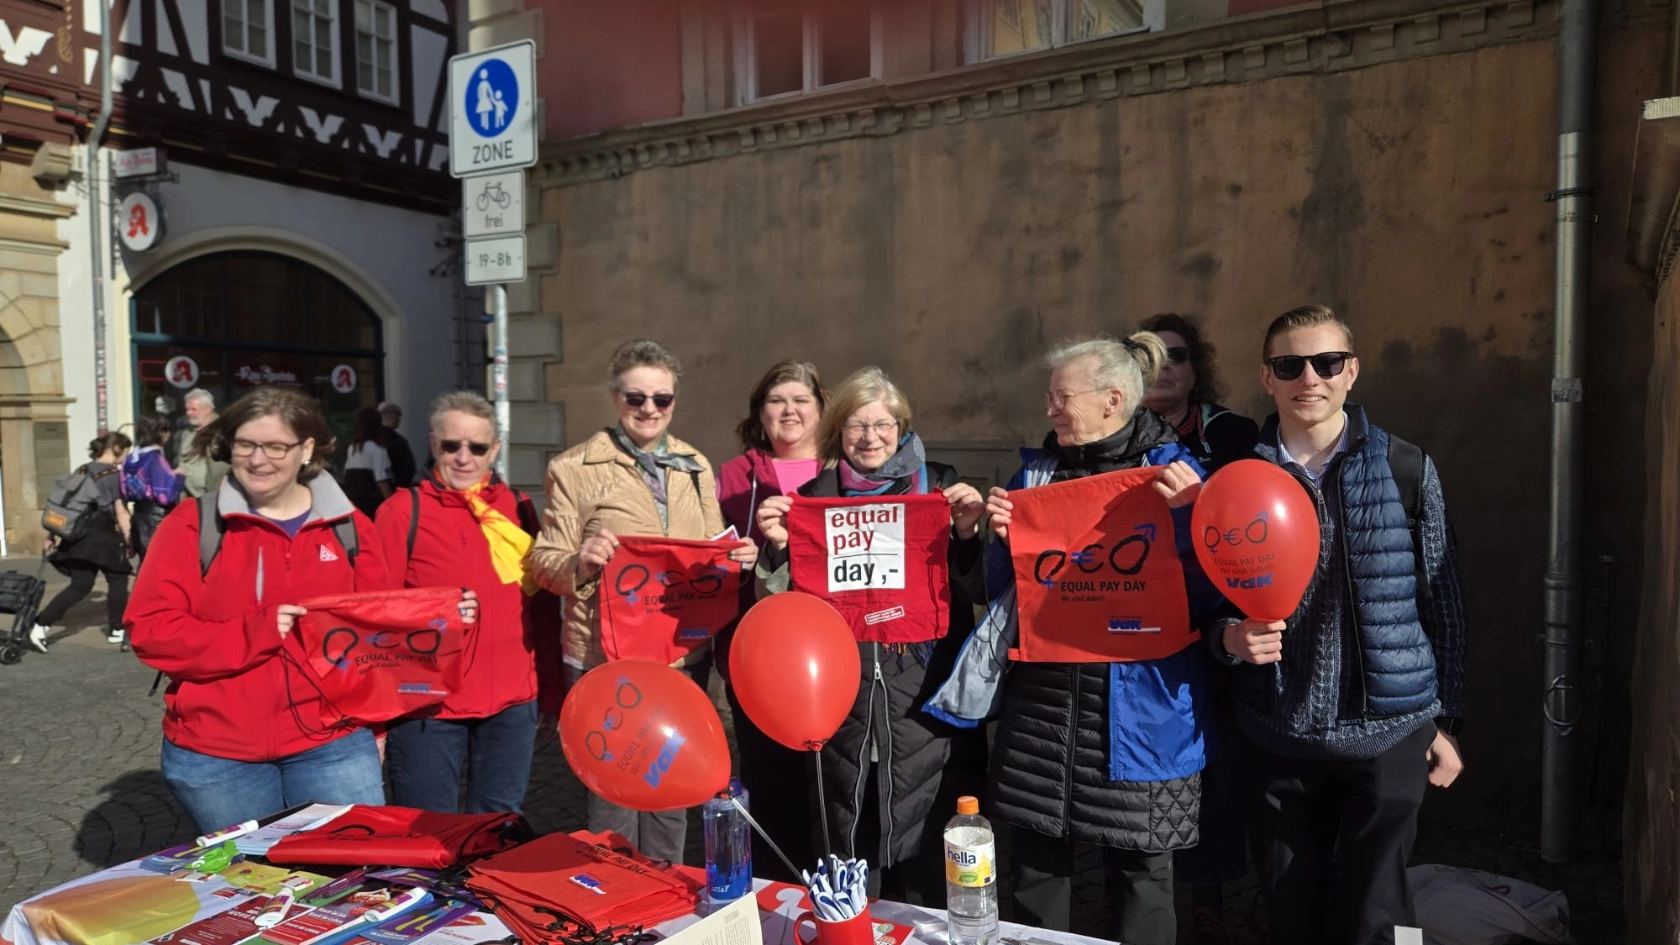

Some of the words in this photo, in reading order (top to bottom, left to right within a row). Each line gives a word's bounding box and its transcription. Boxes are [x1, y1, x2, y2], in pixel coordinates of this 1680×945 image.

[472, 140, 514, 165] ZONE
[484, 213, 504, 229] frei
[830, 505, 899, 530] equal
[831, 529, 876, 556] pay
[1239, 556, 1255, 566] PAY
[1257, 552, 1276, 563] DAY
[833, 559, 876, 586] day
[1060, 580, 1097, 594] EQUAL
[1099, 581, 1120, 592] PAY
[1123, 580, 1146, 592] DAY
[644, 593, 675, 606] EQUAL
[678, 591, 695, 601] PAY
[354, 653, 391, 667] EQUAL
[394, 654, 415, 662] PAY
[418, 655, 439, 664] DAY
[616, 741, 640, 772] EQUAL
[947, 846, 977, 865] hella
